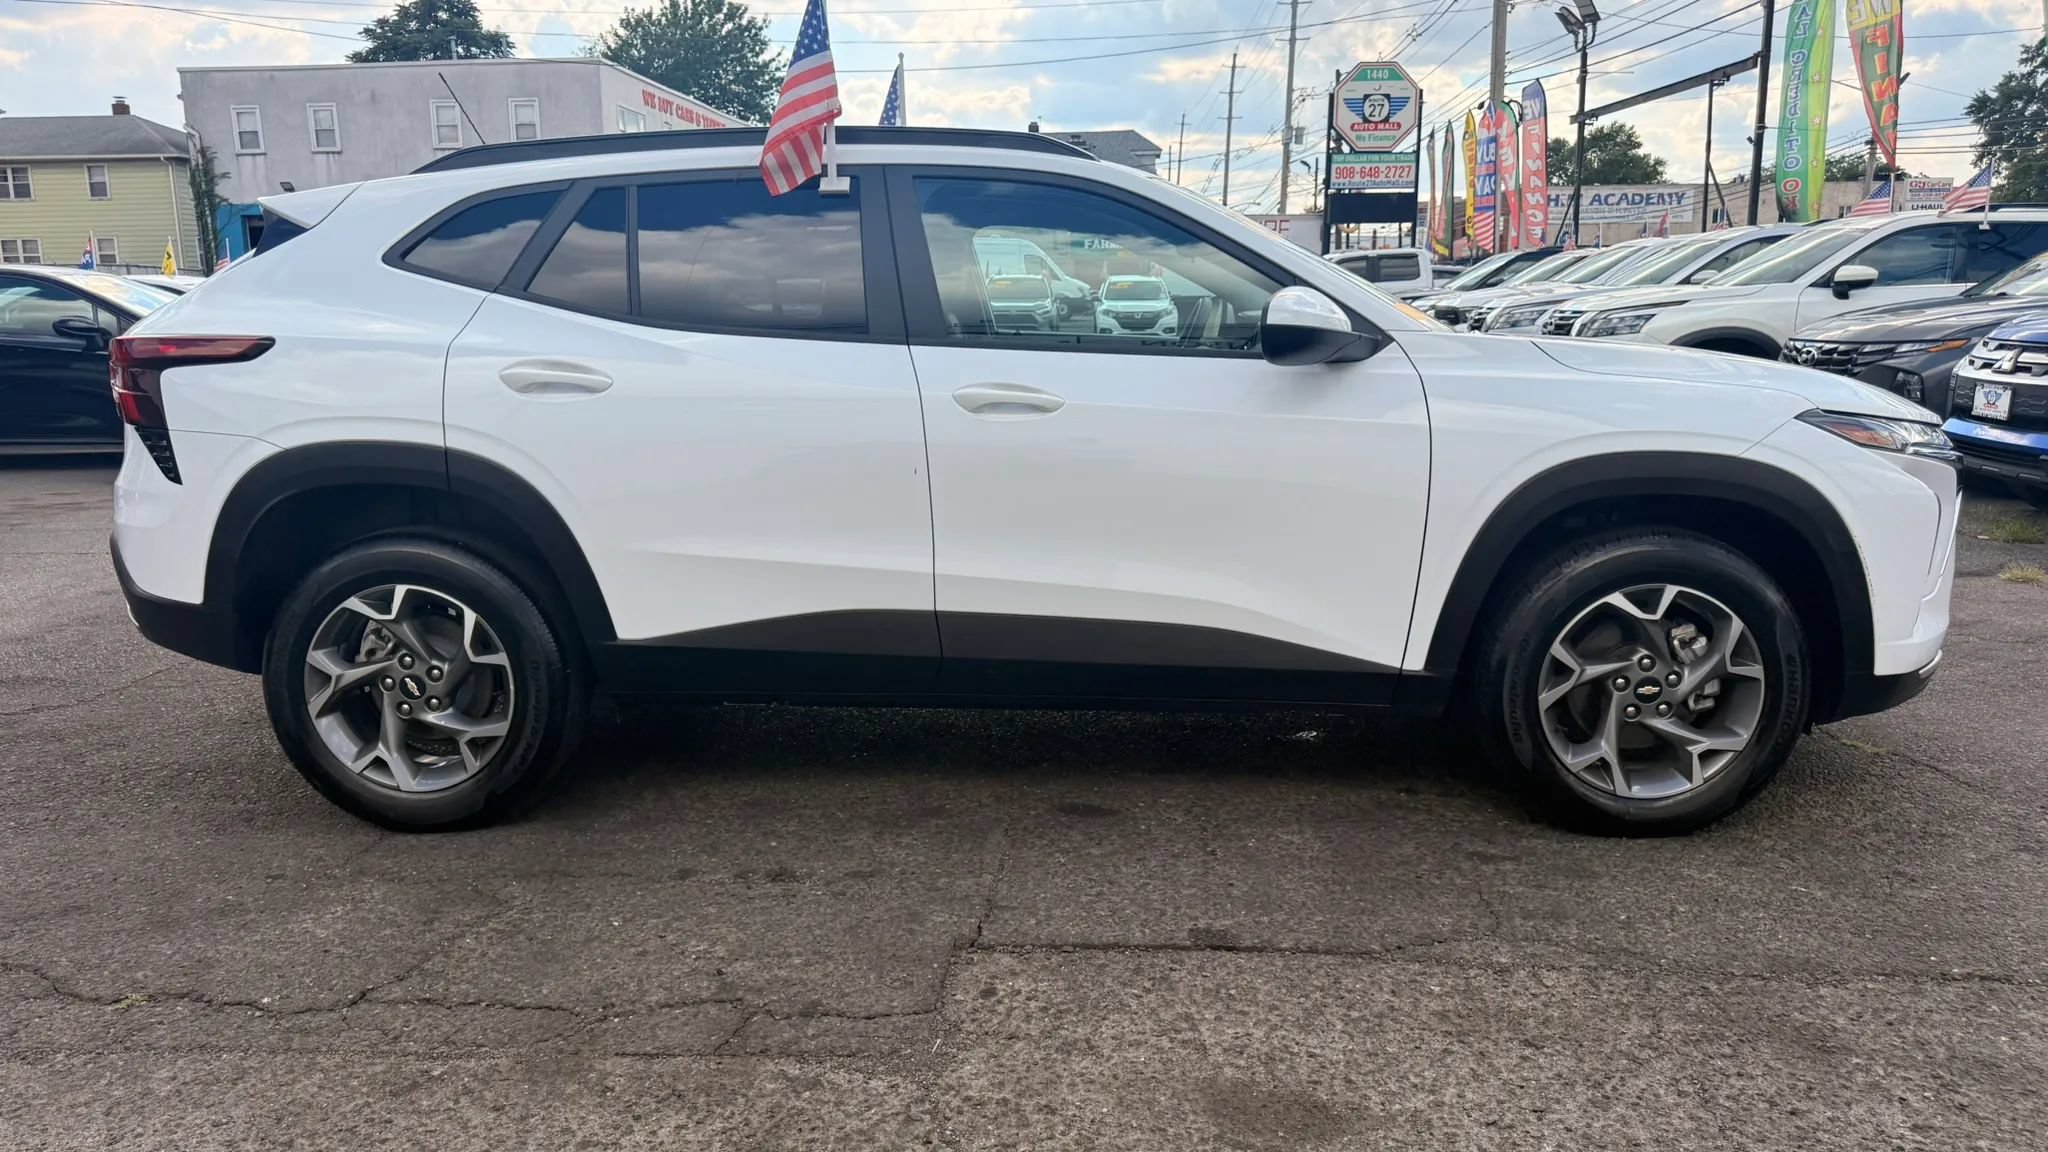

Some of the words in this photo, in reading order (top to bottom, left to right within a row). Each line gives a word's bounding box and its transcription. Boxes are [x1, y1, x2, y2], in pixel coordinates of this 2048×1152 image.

[1367, 69, 1389, 80] 1440
[642, 89, 656, 109] WE
[658, 96, 673, 116] BUY
[676, 103, 694, 124] CARS
[1368, 104, 1385, 118] 27
[1353, 123, 1375, 131] AUTO
[1377, 122, 1399, 130] MALL
[1355, 134, 1366, 142] We
[1368, 133, 1396, 142] Finance
[1335, 165, 1412, 179] 908-648-2727
[1589, 192, 1686, 206] ACADEMY
